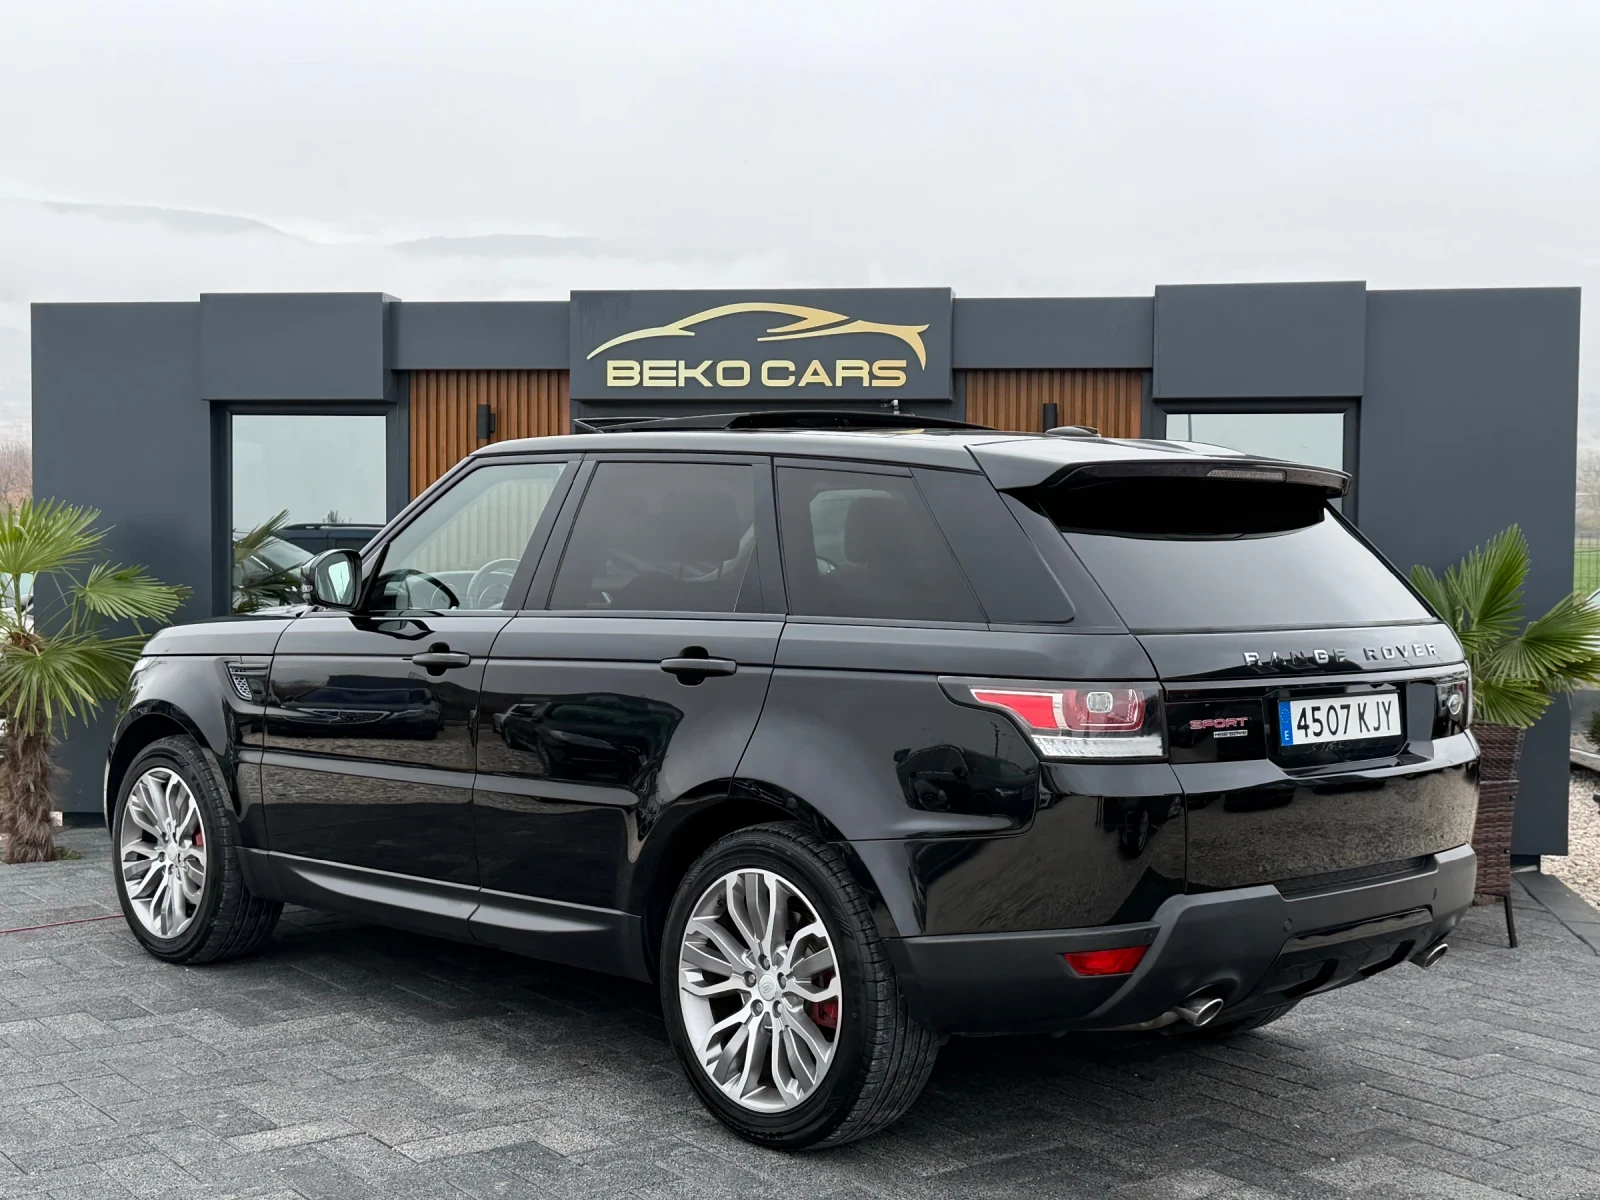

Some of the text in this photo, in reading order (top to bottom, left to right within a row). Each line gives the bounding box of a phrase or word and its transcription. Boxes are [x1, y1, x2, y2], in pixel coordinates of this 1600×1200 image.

[606, 360, 907, 387] BEKO CARS
[1243, 642, 1437, 667] RANGE ROVER
[1189, 717, 1249, 730] SPORT
[1296, 700, 1392, 738] 4507 KJY
[1284, 730, 1290, 741] E
